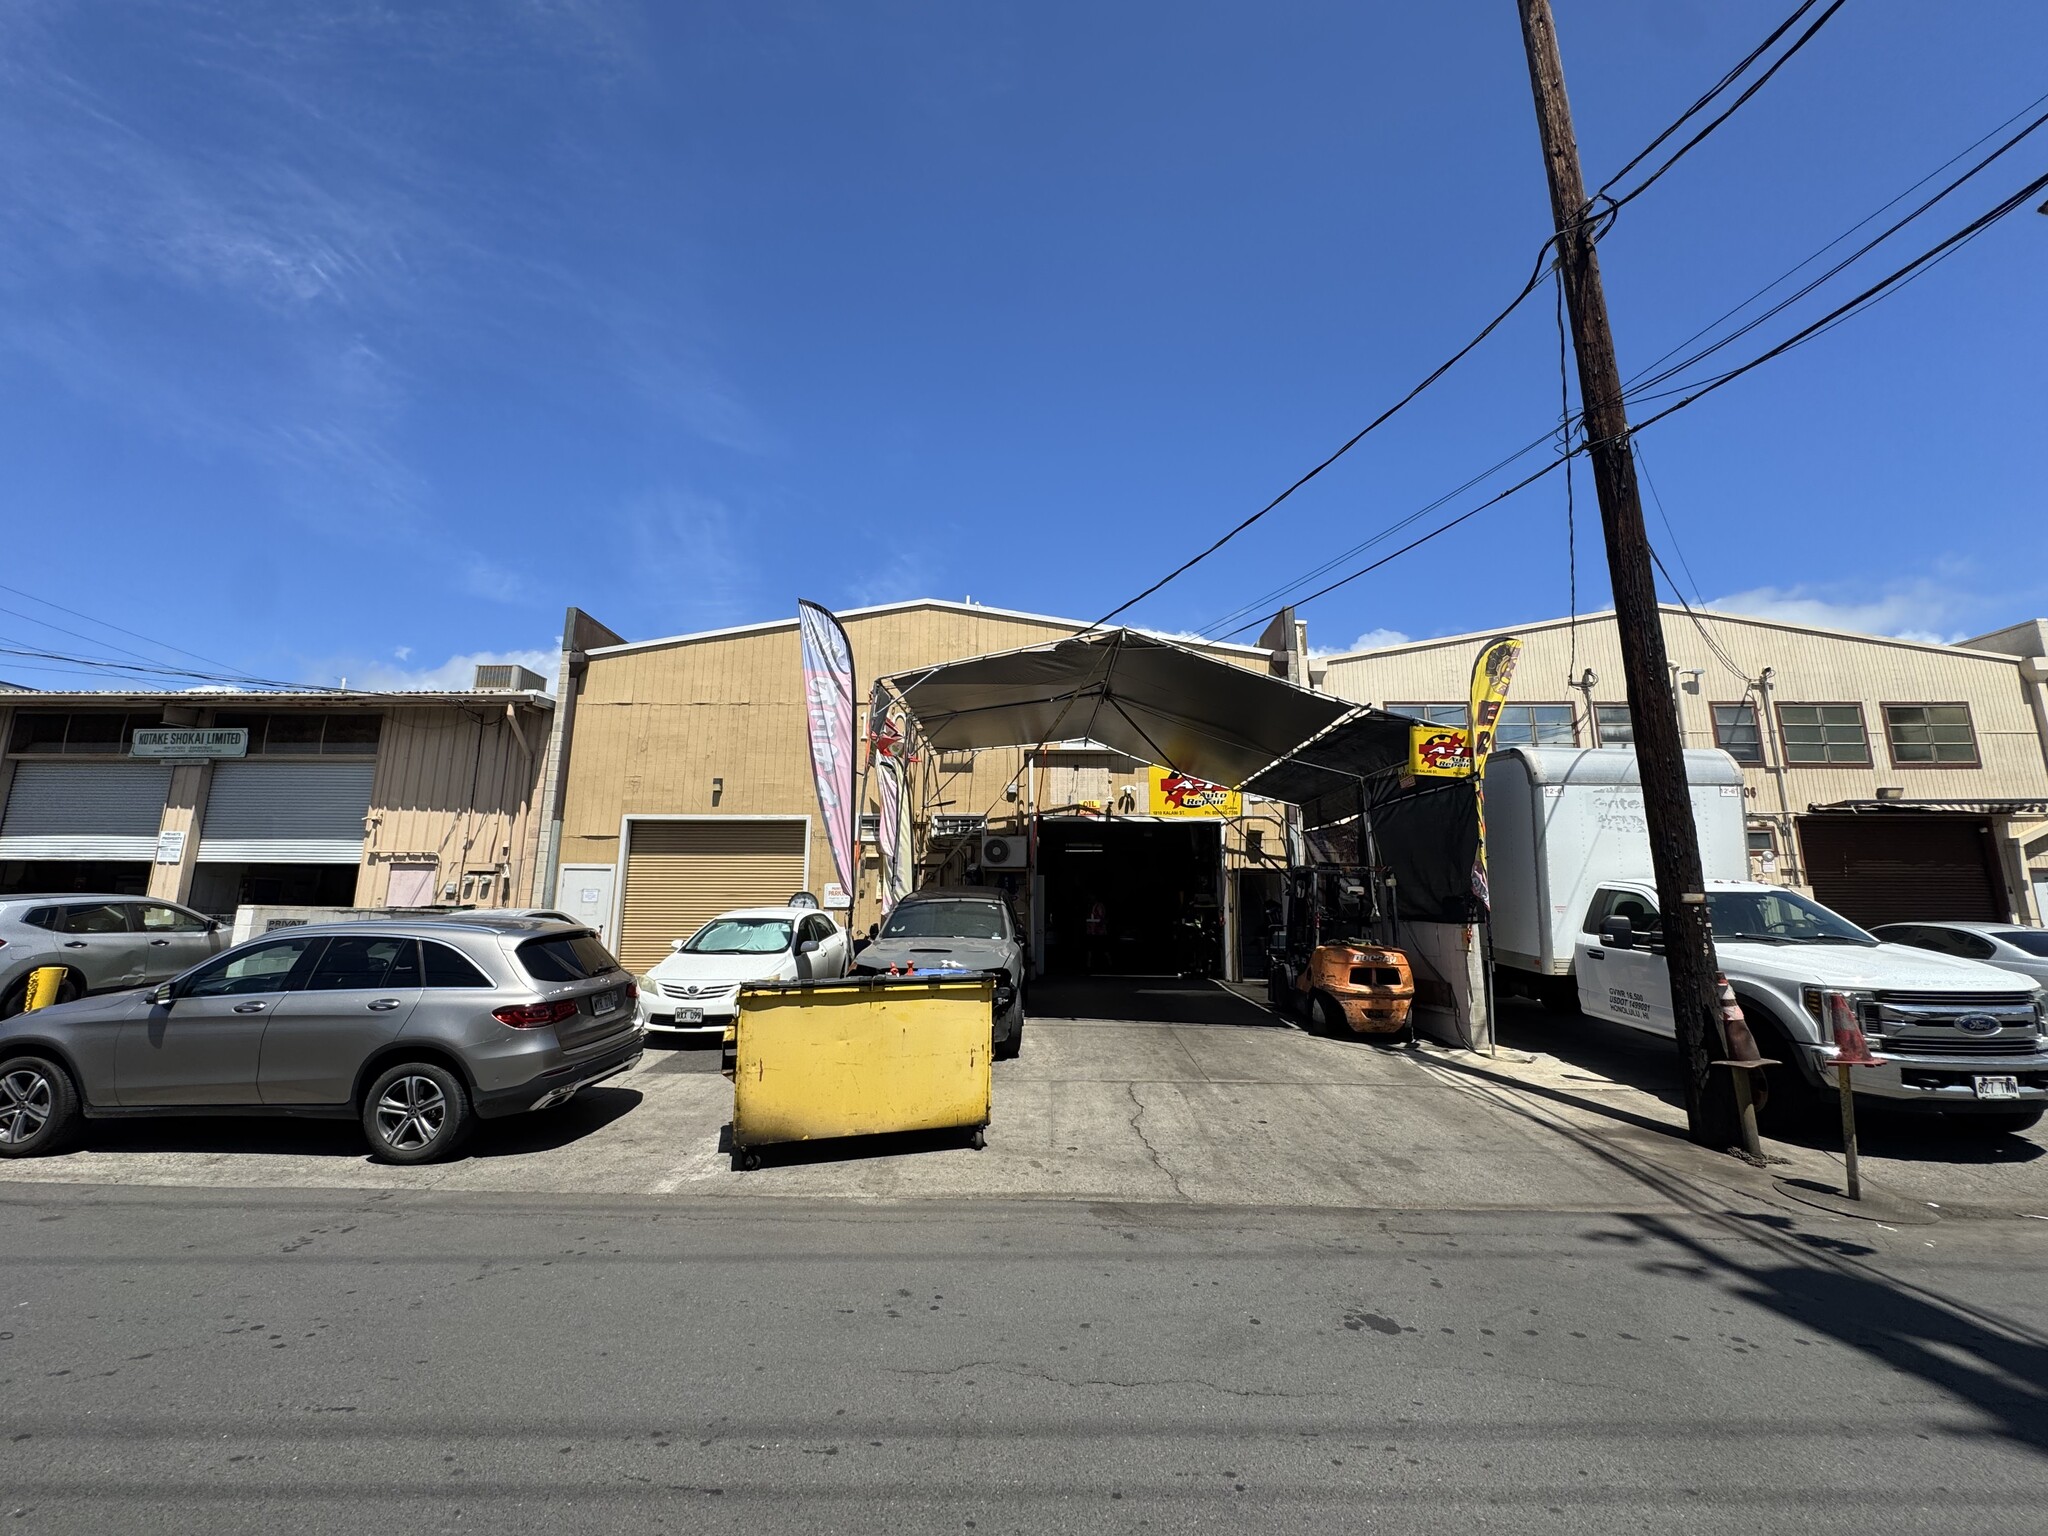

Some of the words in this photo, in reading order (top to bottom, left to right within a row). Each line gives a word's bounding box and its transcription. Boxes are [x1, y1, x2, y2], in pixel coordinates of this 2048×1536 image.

[138, 733, 169, 745] KOTAKE
[170, 733, 204, 745] SHOKAI
[206, 733, 241, 745] LIMITED
[1428, 746, 1465, 754] A-1
[1199, 791, 1228, 799] Auto
[1186, 798, 1226, 806] Repair
[1609, 995, 1628, 1006] USDOT
[1969, 1020, 1991, 1030] Ford
